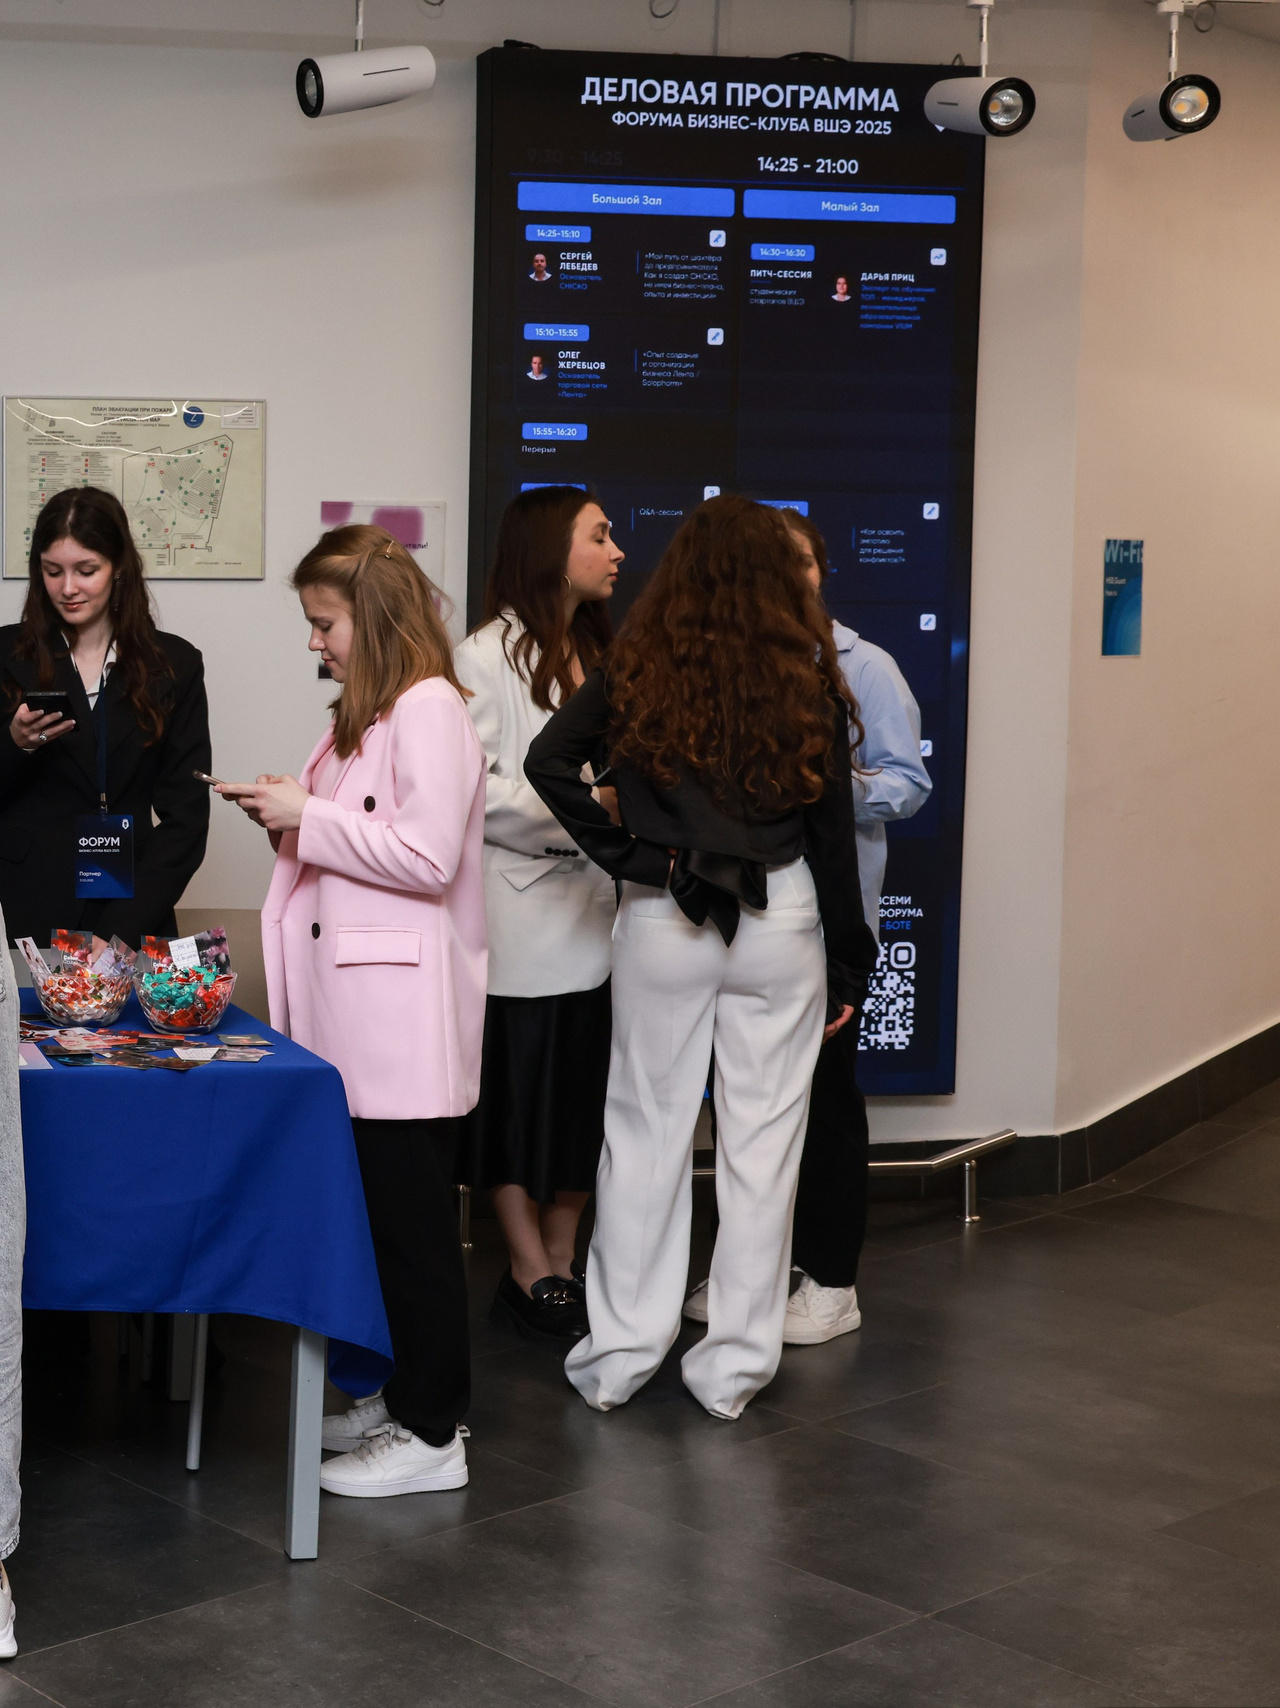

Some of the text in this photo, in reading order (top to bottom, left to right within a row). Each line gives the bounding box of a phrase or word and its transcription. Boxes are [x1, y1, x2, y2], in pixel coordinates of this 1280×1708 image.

[581, 77, 899, 113] ДЕЛОВАЯ ПРОГРАММА
[611, 110, 892, 135] ФОРУМА БИЗНЕС-КЛУБА ВШЭ 2025
[757, 155, 798, 173] 14:25
[815, 158, 859, 175] 21:00
[592, 192, 662, 207] Большой Зал
[821, 201, 880, 214] Малый Зал
[536, 229, 580, 239] 14:25-15:10
[560, 251, 592, 261] СЕРГЕЙ
[559, 262, 598, 272] ЛЕБЕДЕВ
[750, 269, 812, 279] ПИТЧ-СЕССИЯ
[861, 273, 915, 283] ДАРЬЯ ПРИЦ
[535, 328, 578, 337] 15:10-15:55
[558, 350, 580, 359] ОЛЕГ
[558, 360, 605, 370] ЖЕРЕБЦОВ
[533, 427, 577, 436] 15:55-16:20
[78, 837, 120, 847] ФОРУМ
[878, 908, 924, 918] ФОРУМА
